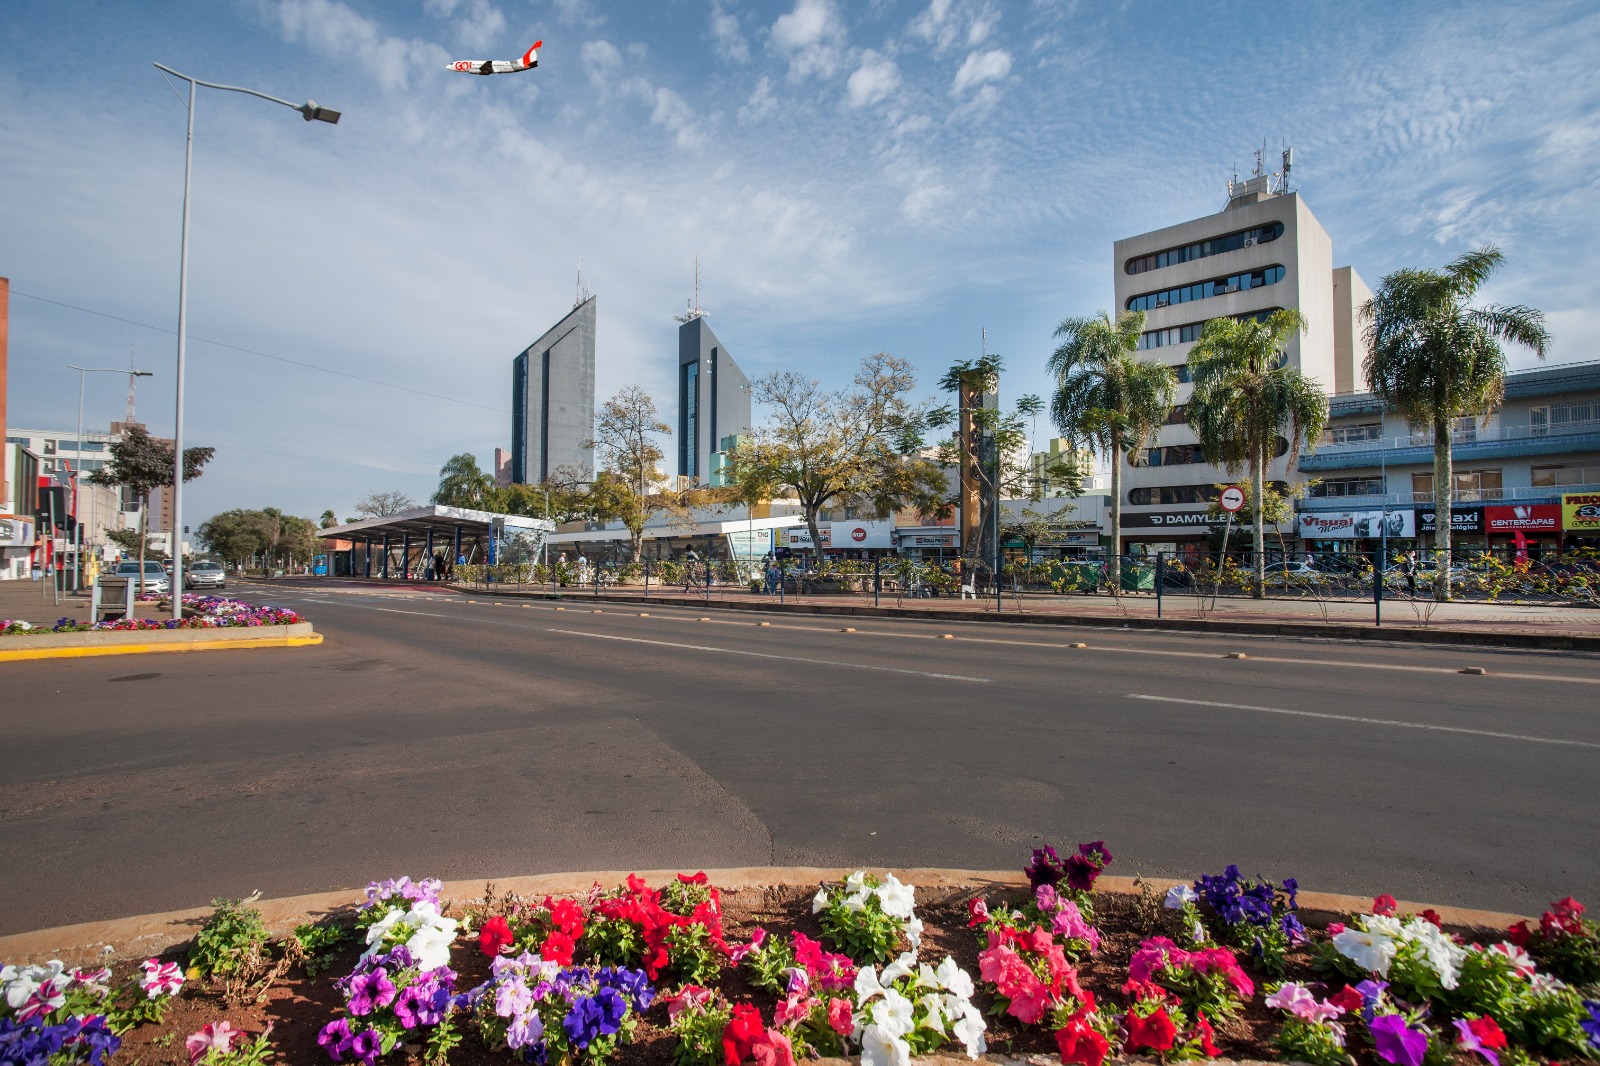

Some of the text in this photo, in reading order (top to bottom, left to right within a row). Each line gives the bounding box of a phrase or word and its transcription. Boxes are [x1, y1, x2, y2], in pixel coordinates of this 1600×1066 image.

[1565, 495, 1600, 506] PREÇ
[1452, 511, 1478, 522] axi
[1491, 518, 1555, 527] CENTERCAPAS
